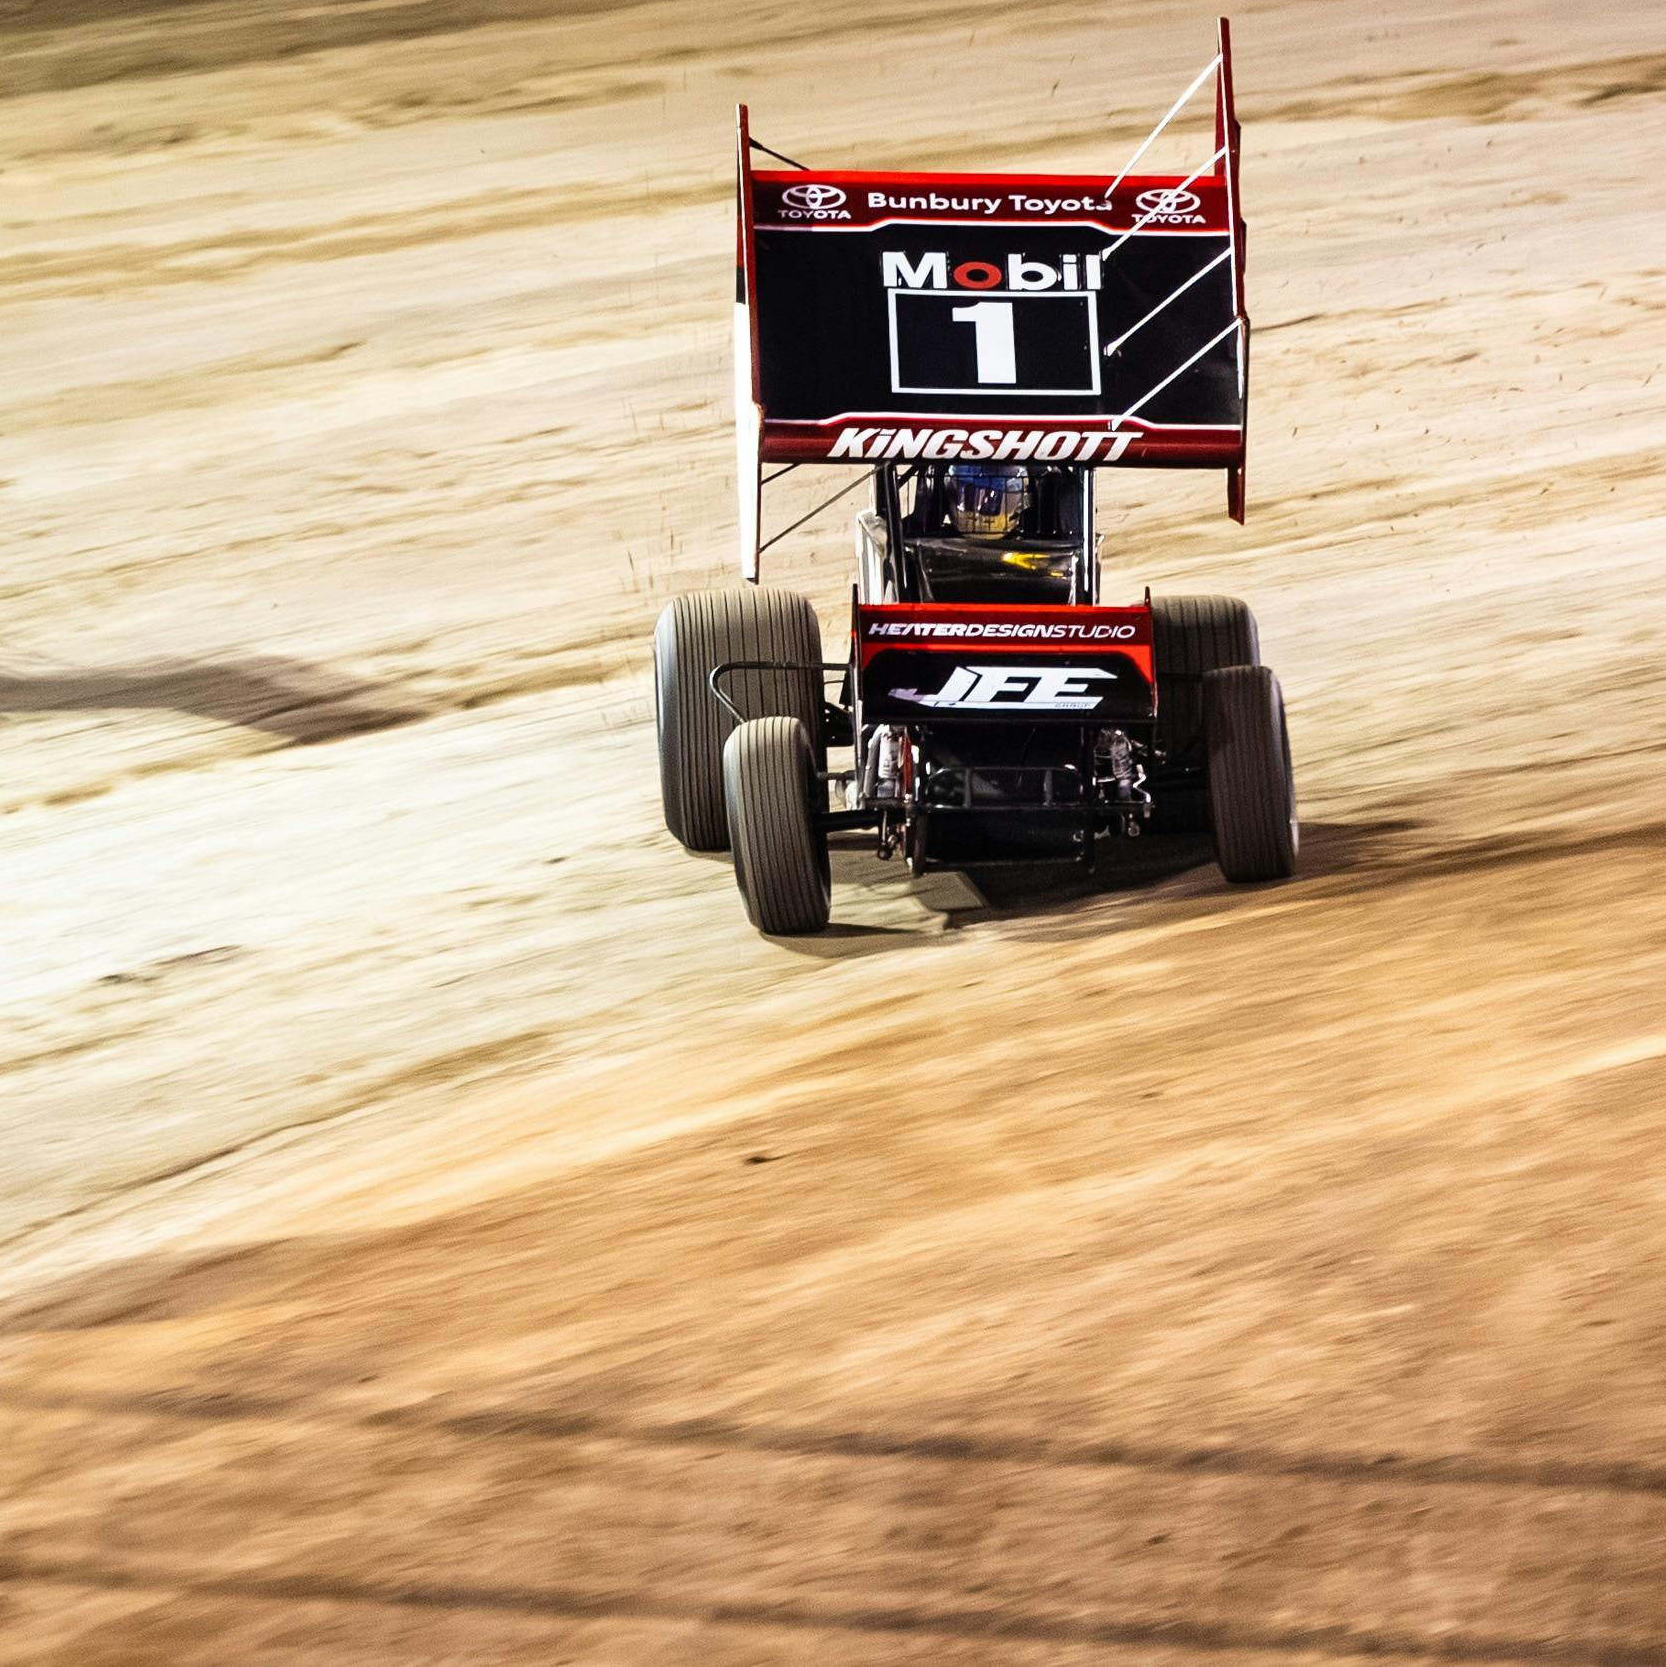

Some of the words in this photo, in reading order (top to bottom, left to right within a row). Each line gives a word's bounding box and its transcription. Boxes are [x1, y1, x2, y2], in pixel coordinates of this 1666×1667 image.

[776, 209, 852, 220] TOYOTA
[867, 192, 1001, 215] Bunbury
[1008, 194, 1113, 214] Toyota
[1131, 213, 1206, 225] TOYOTA
[882, 251, 1102, 290] Mobil
[952, 301, 1017, 384] 1
